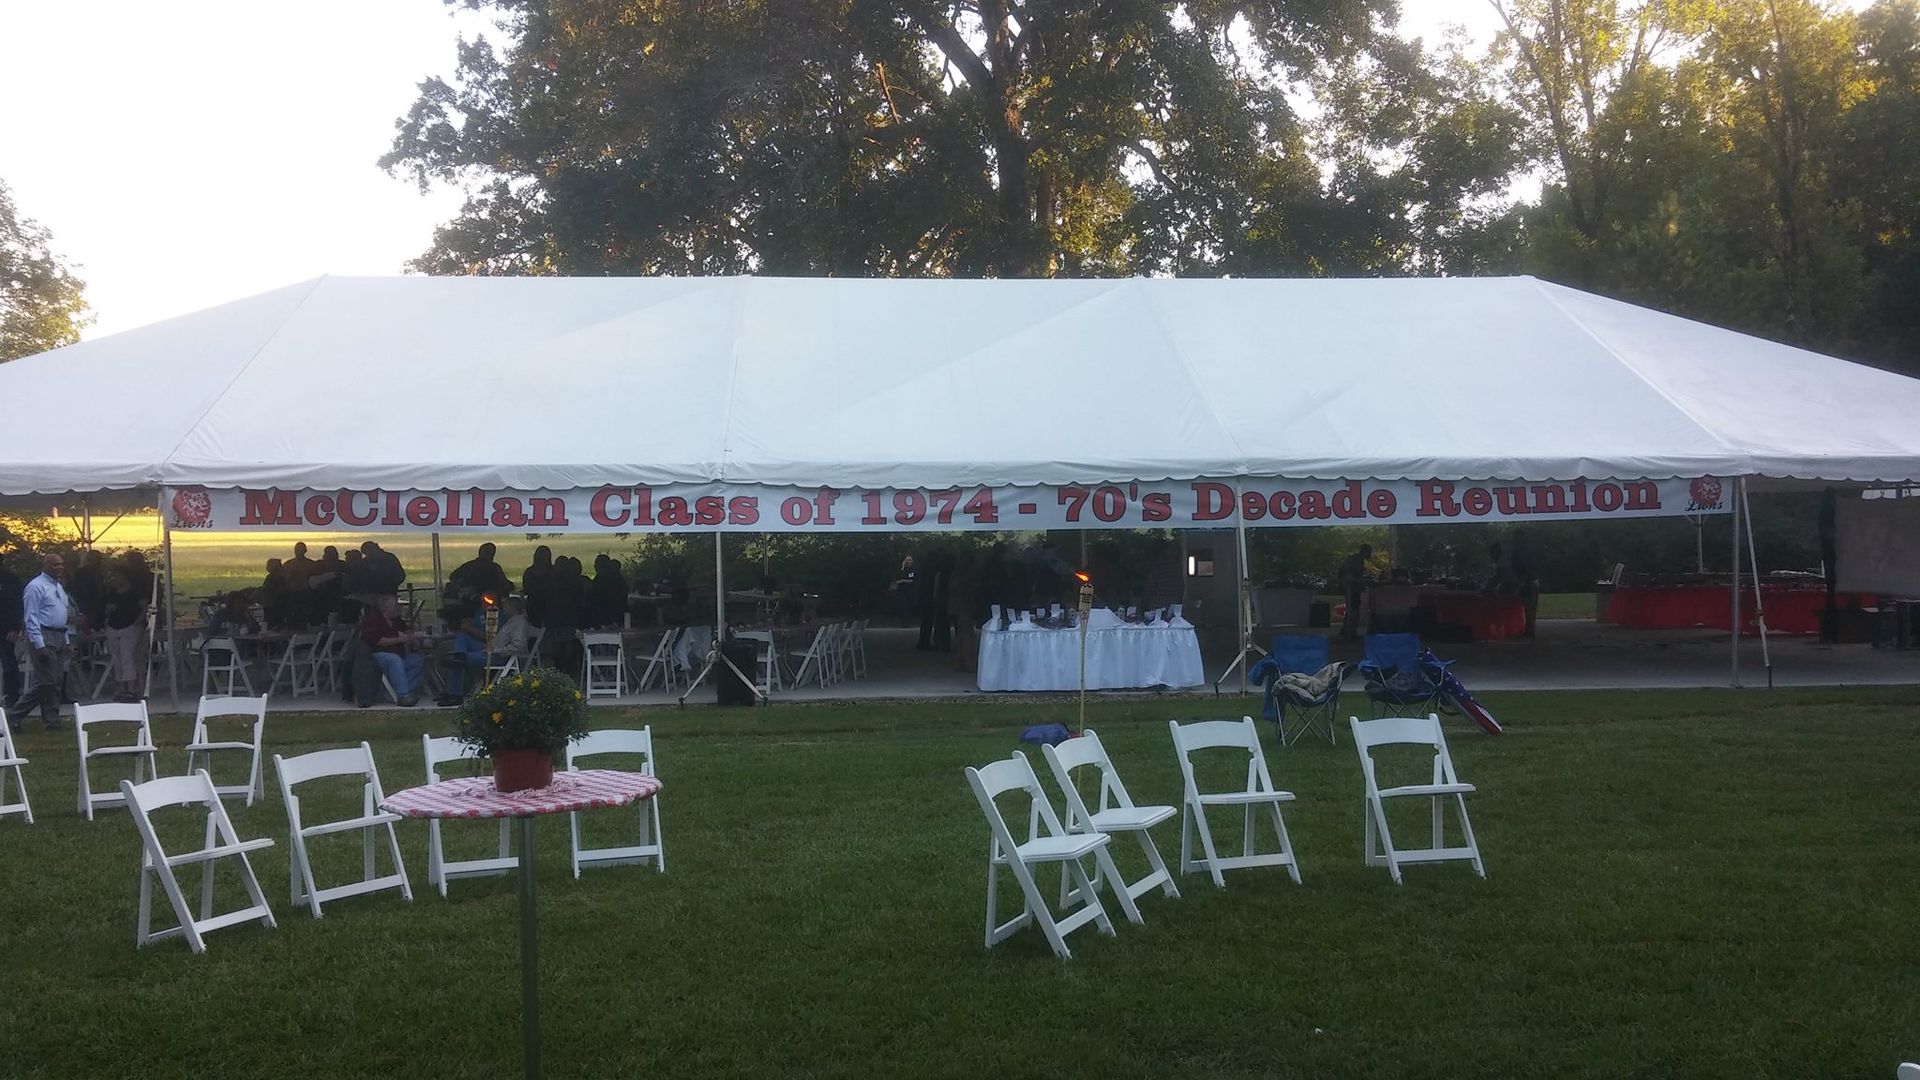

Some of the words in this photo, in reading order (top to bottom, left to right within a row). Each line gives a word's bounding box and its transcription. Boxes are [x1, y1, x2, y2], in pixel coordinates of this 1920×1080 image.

[239, 489, 569, 527] McClellan
[590, 486, 760, 527] Class
[780, 486, 840, 526] of
[861, 488, 999, 526] 1974
[1057, 483, 1172, 523] 70's
[1192, 480, 1398, 521] Decade
[1415, 477, 1662, 517] Reunion
[1685, 499, 1724, 512] Lions
